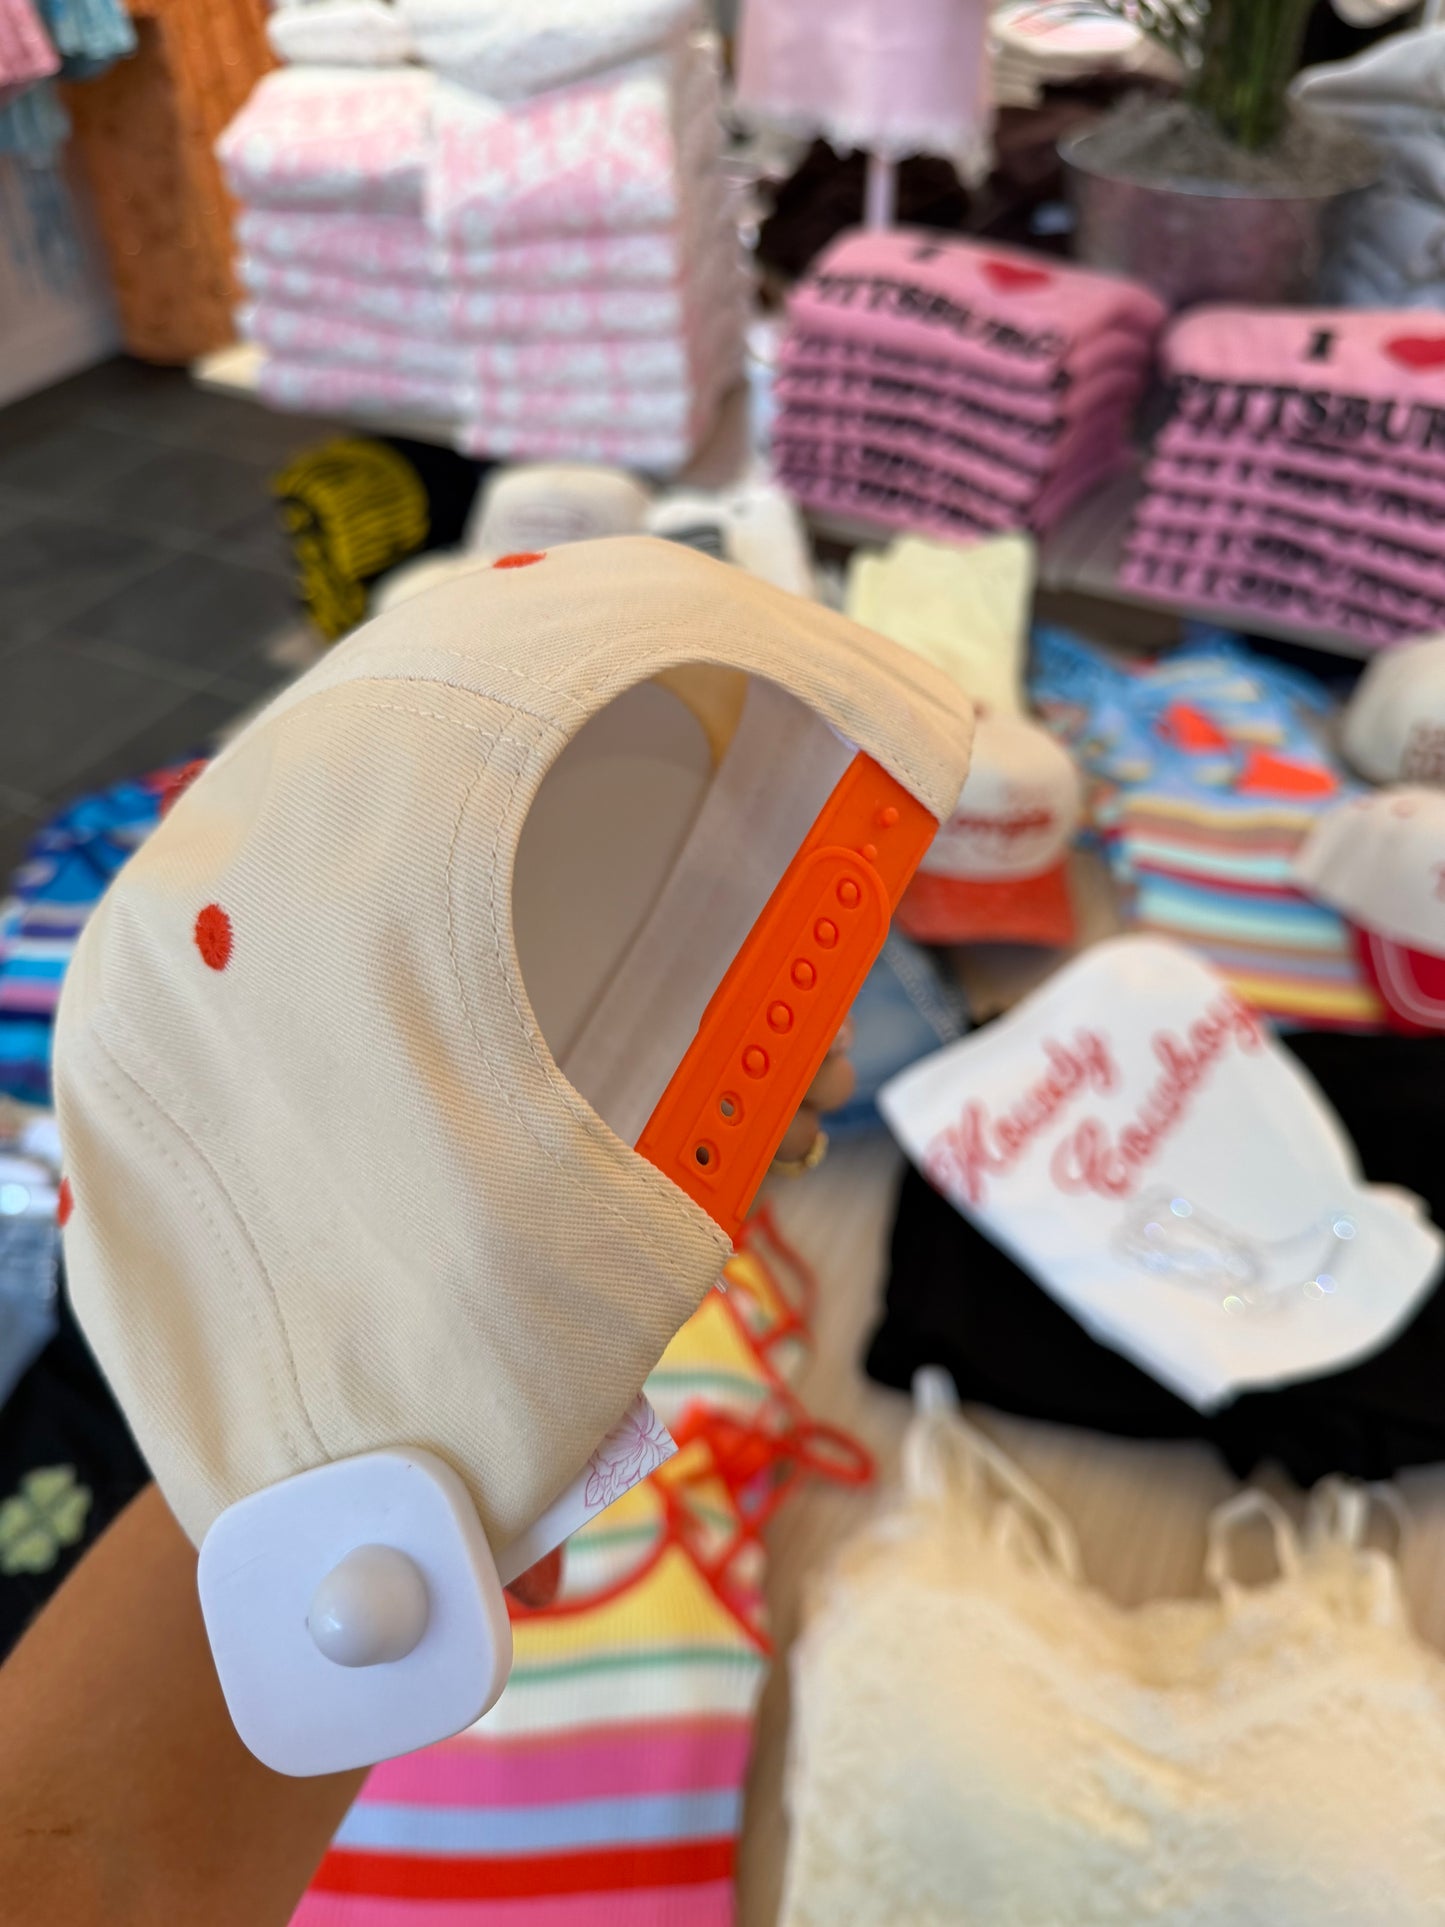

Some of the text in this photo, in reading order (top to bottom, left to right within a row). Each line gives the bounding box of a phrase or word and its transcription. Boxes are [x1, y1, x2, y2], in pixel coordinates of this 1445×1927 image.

[1305, 328, 1338, 362] I
[923, 1026, 1119, 1203] Howdy
[1050, 990, 1266, 1199] Cowboy
